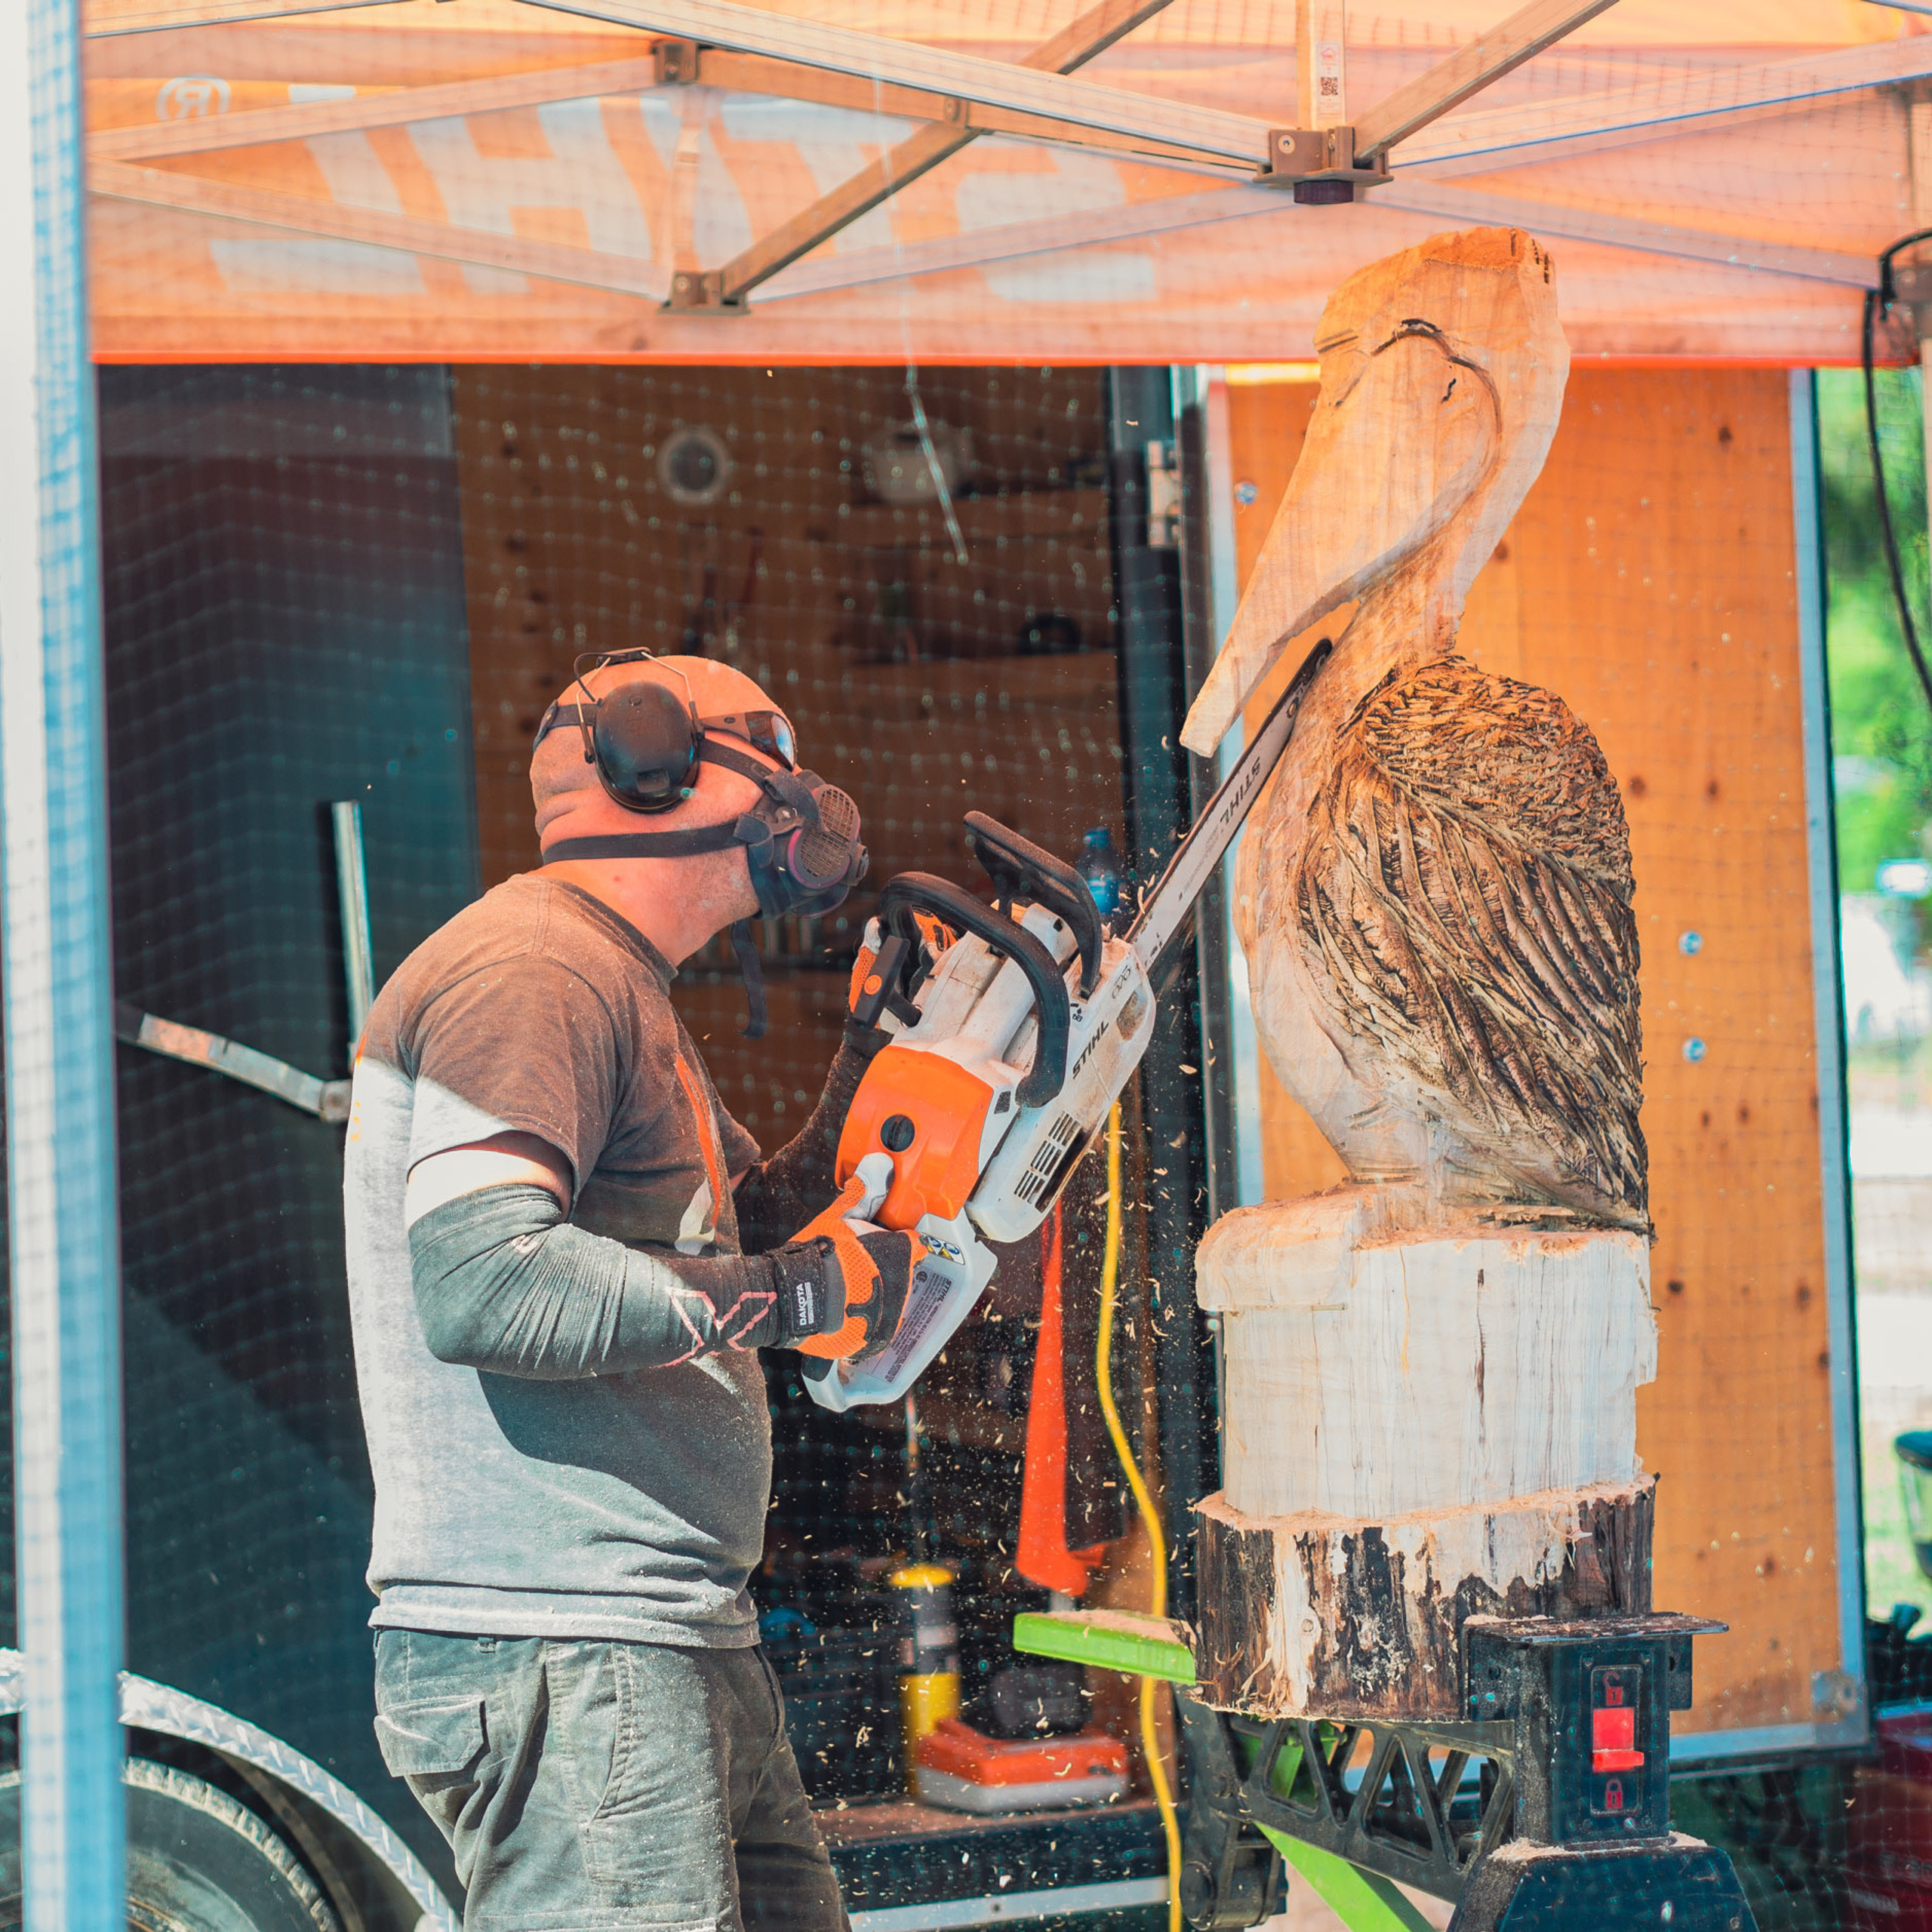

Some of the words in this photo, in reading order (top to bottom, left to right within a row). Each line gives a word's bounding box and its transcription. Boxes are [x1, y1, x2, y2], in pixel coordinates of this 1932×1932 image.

[1220, 756, 1261, 826] STIHL
[1072, 1020, 1109, 1079] STIHL
[796, 1283, 808, 1326] DAKOTA
[937, 1278, 952, 1303] STIHL
